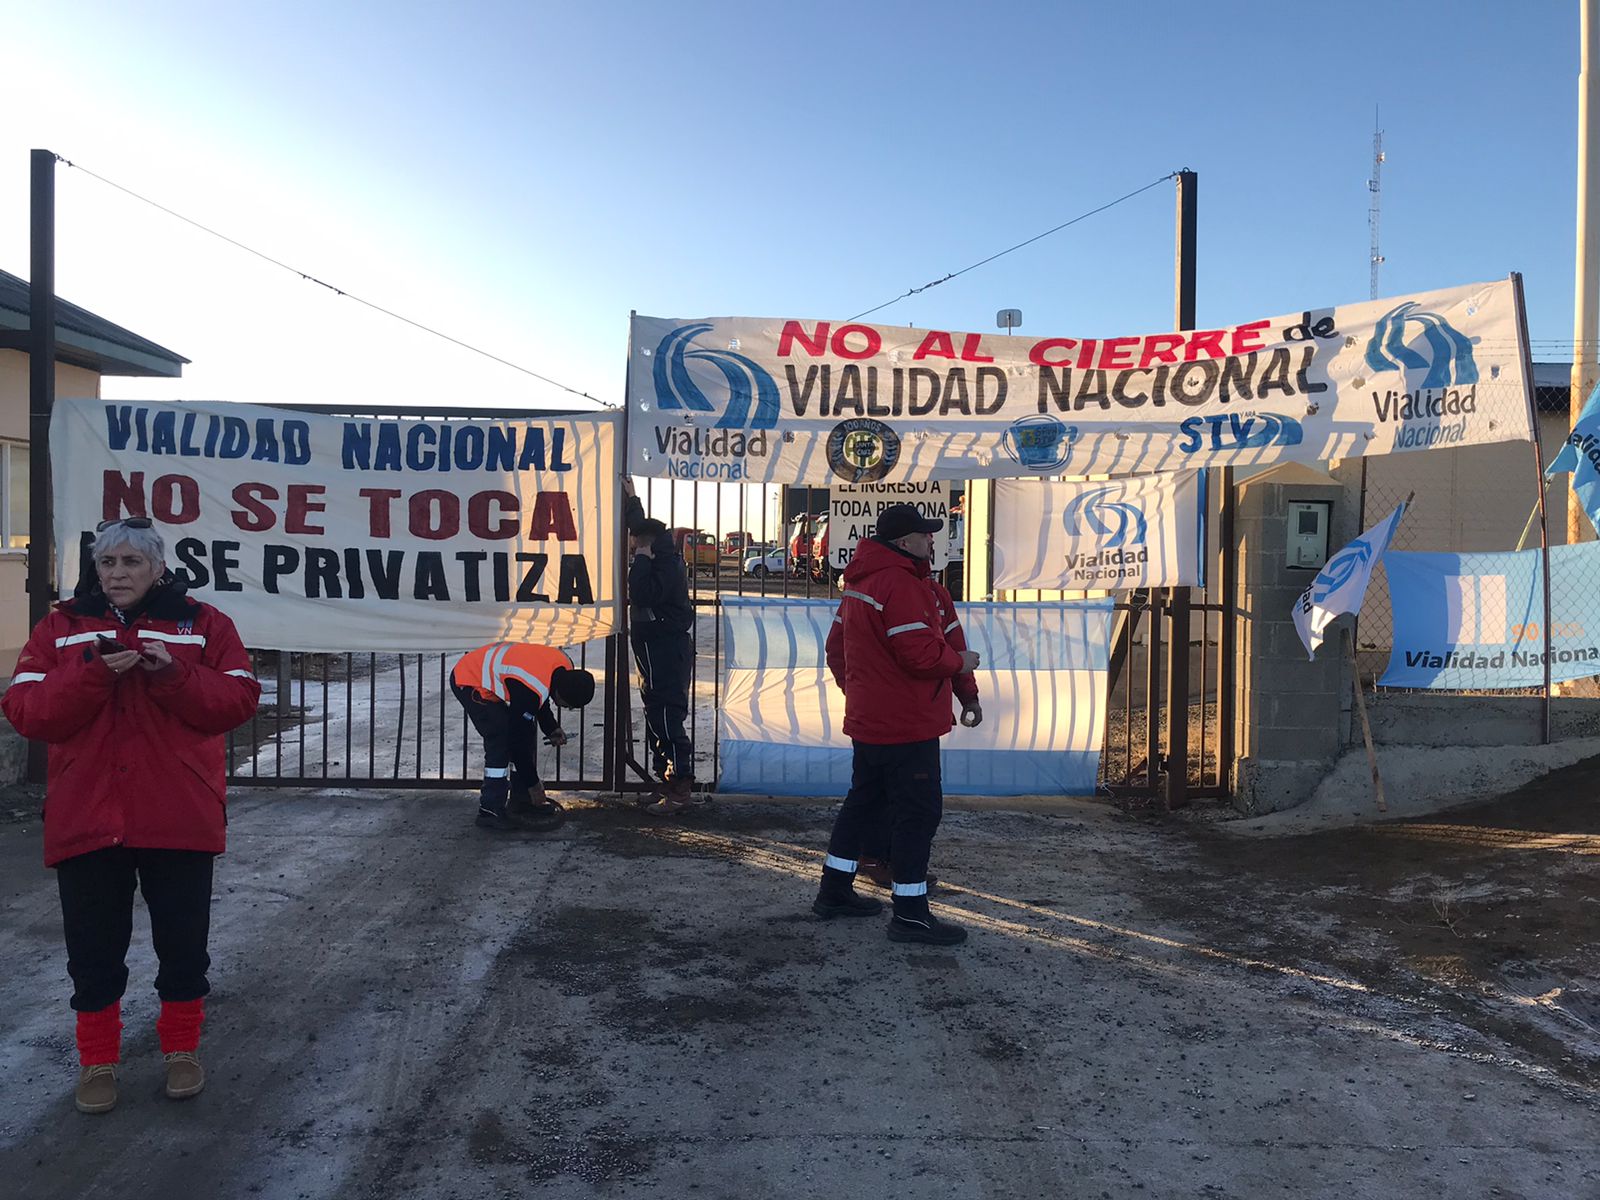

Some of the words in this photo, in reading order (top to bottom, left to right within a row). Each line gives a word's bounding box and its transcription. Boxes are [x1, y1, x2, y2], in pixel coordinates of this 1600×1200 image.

[777, 320, 882, 360] NO
[913, 330, 995, 363] AL
[1028, 319, 1272, 368] CIERRE
[1283, 311, 1339, 342] de
[784, 363, 1009, 417] VIALIDAD
[1038, 346, 1328, 413] NACIONAL
[1372, 384, 1477, 422] Vialidad
[105, 404, 312, 466] VIALIDAD
[342, 421, 573, 472] NACIONAL
[654, 424, 768, 458] Vialidad
[1393, 414, 1468, 449] Nacional
[667, 456, 751, 480] Nacional
[861, 481, 927, 493] INGRESO
[931, 480, 941, 493] A
[102, 470, 200, 524] NO
[230, 482, 327, 534] SE
[359, 487, 578, 541] TOCA
[832, 500, 872, 517] TODA
[877, 502, 948, 518] PONA
[175, 537, 244, 592] SE
[263, 543, 595, 604] PRIVATIZA
[1064, 547, 1149, 570] Vialidad
[1074, 565, 1141, 581] Nacional
[177, 627, 192, 635] VN
[1406, 648, 1505, 669] Vialidad
